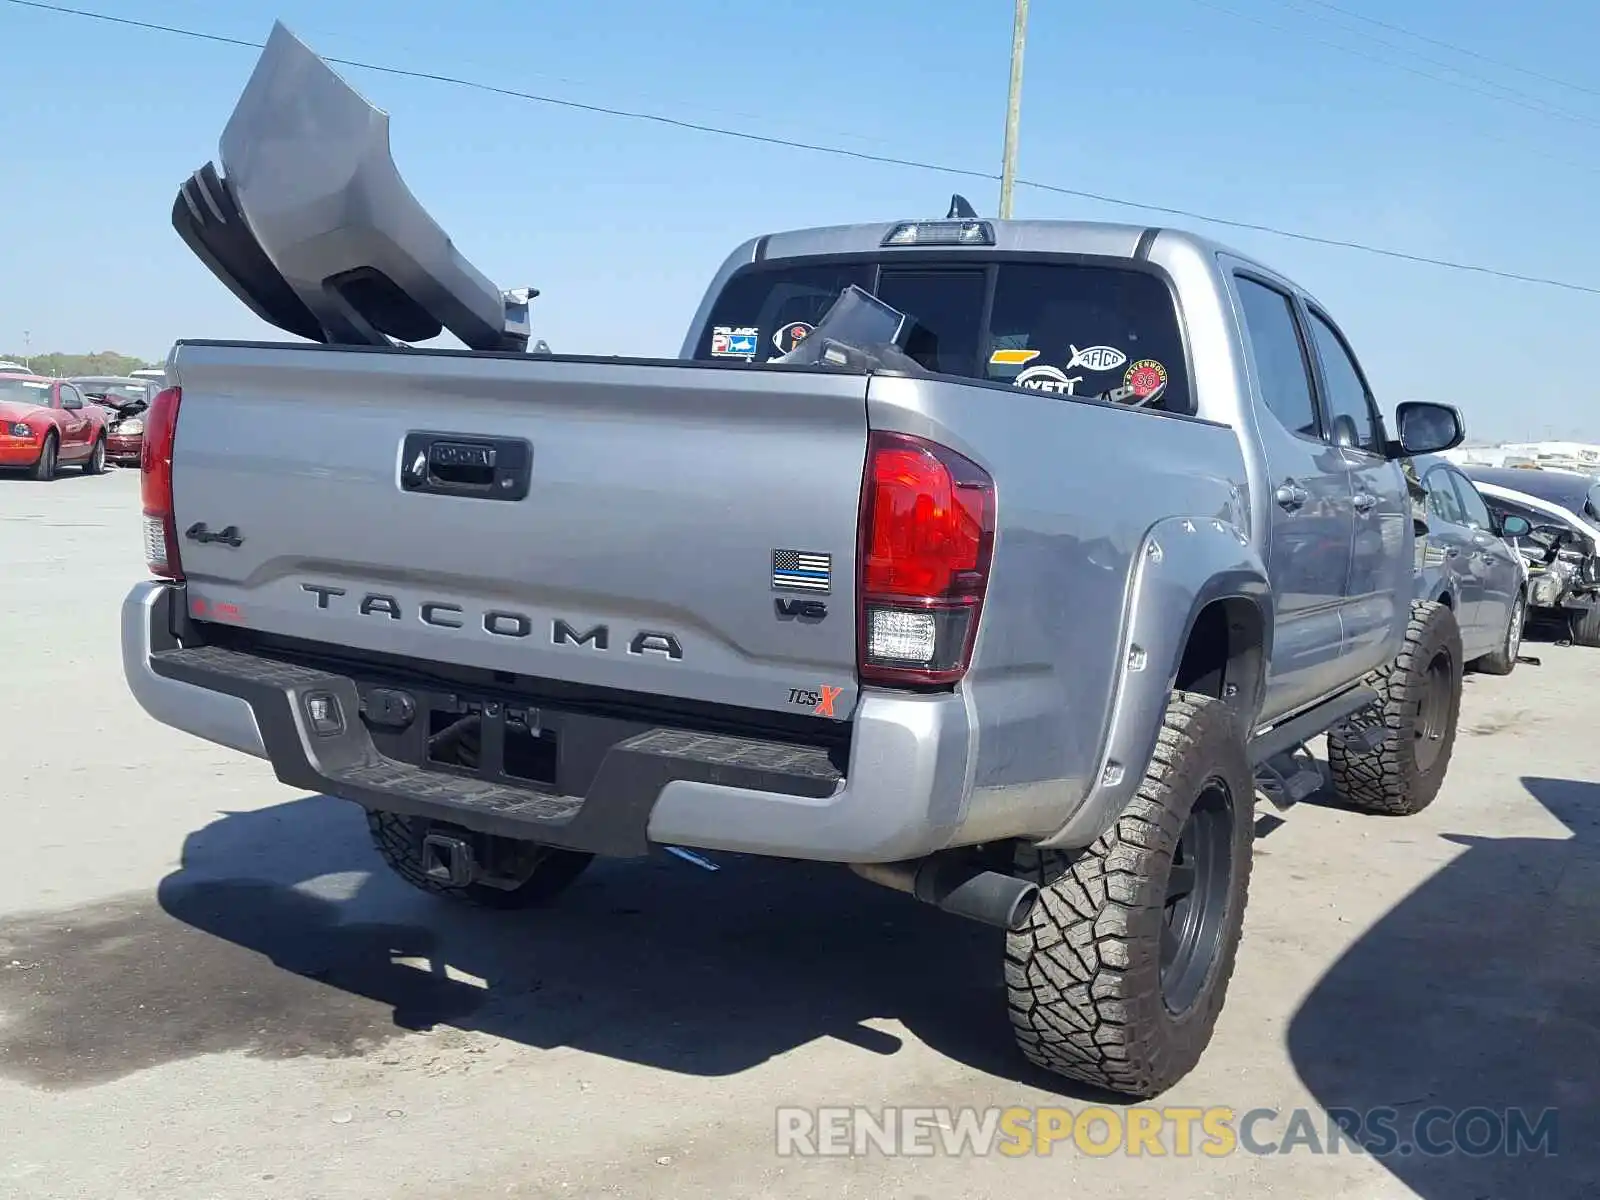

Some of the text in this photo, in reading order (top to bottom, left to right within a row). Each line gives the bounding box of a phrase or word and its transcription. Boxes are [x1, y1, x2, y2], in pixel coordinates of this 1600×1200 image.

[1028, 380, 1075, 397] YETI
[774, 598, 829, 621] V6
[300, 583, 684, 661] TACOMA
